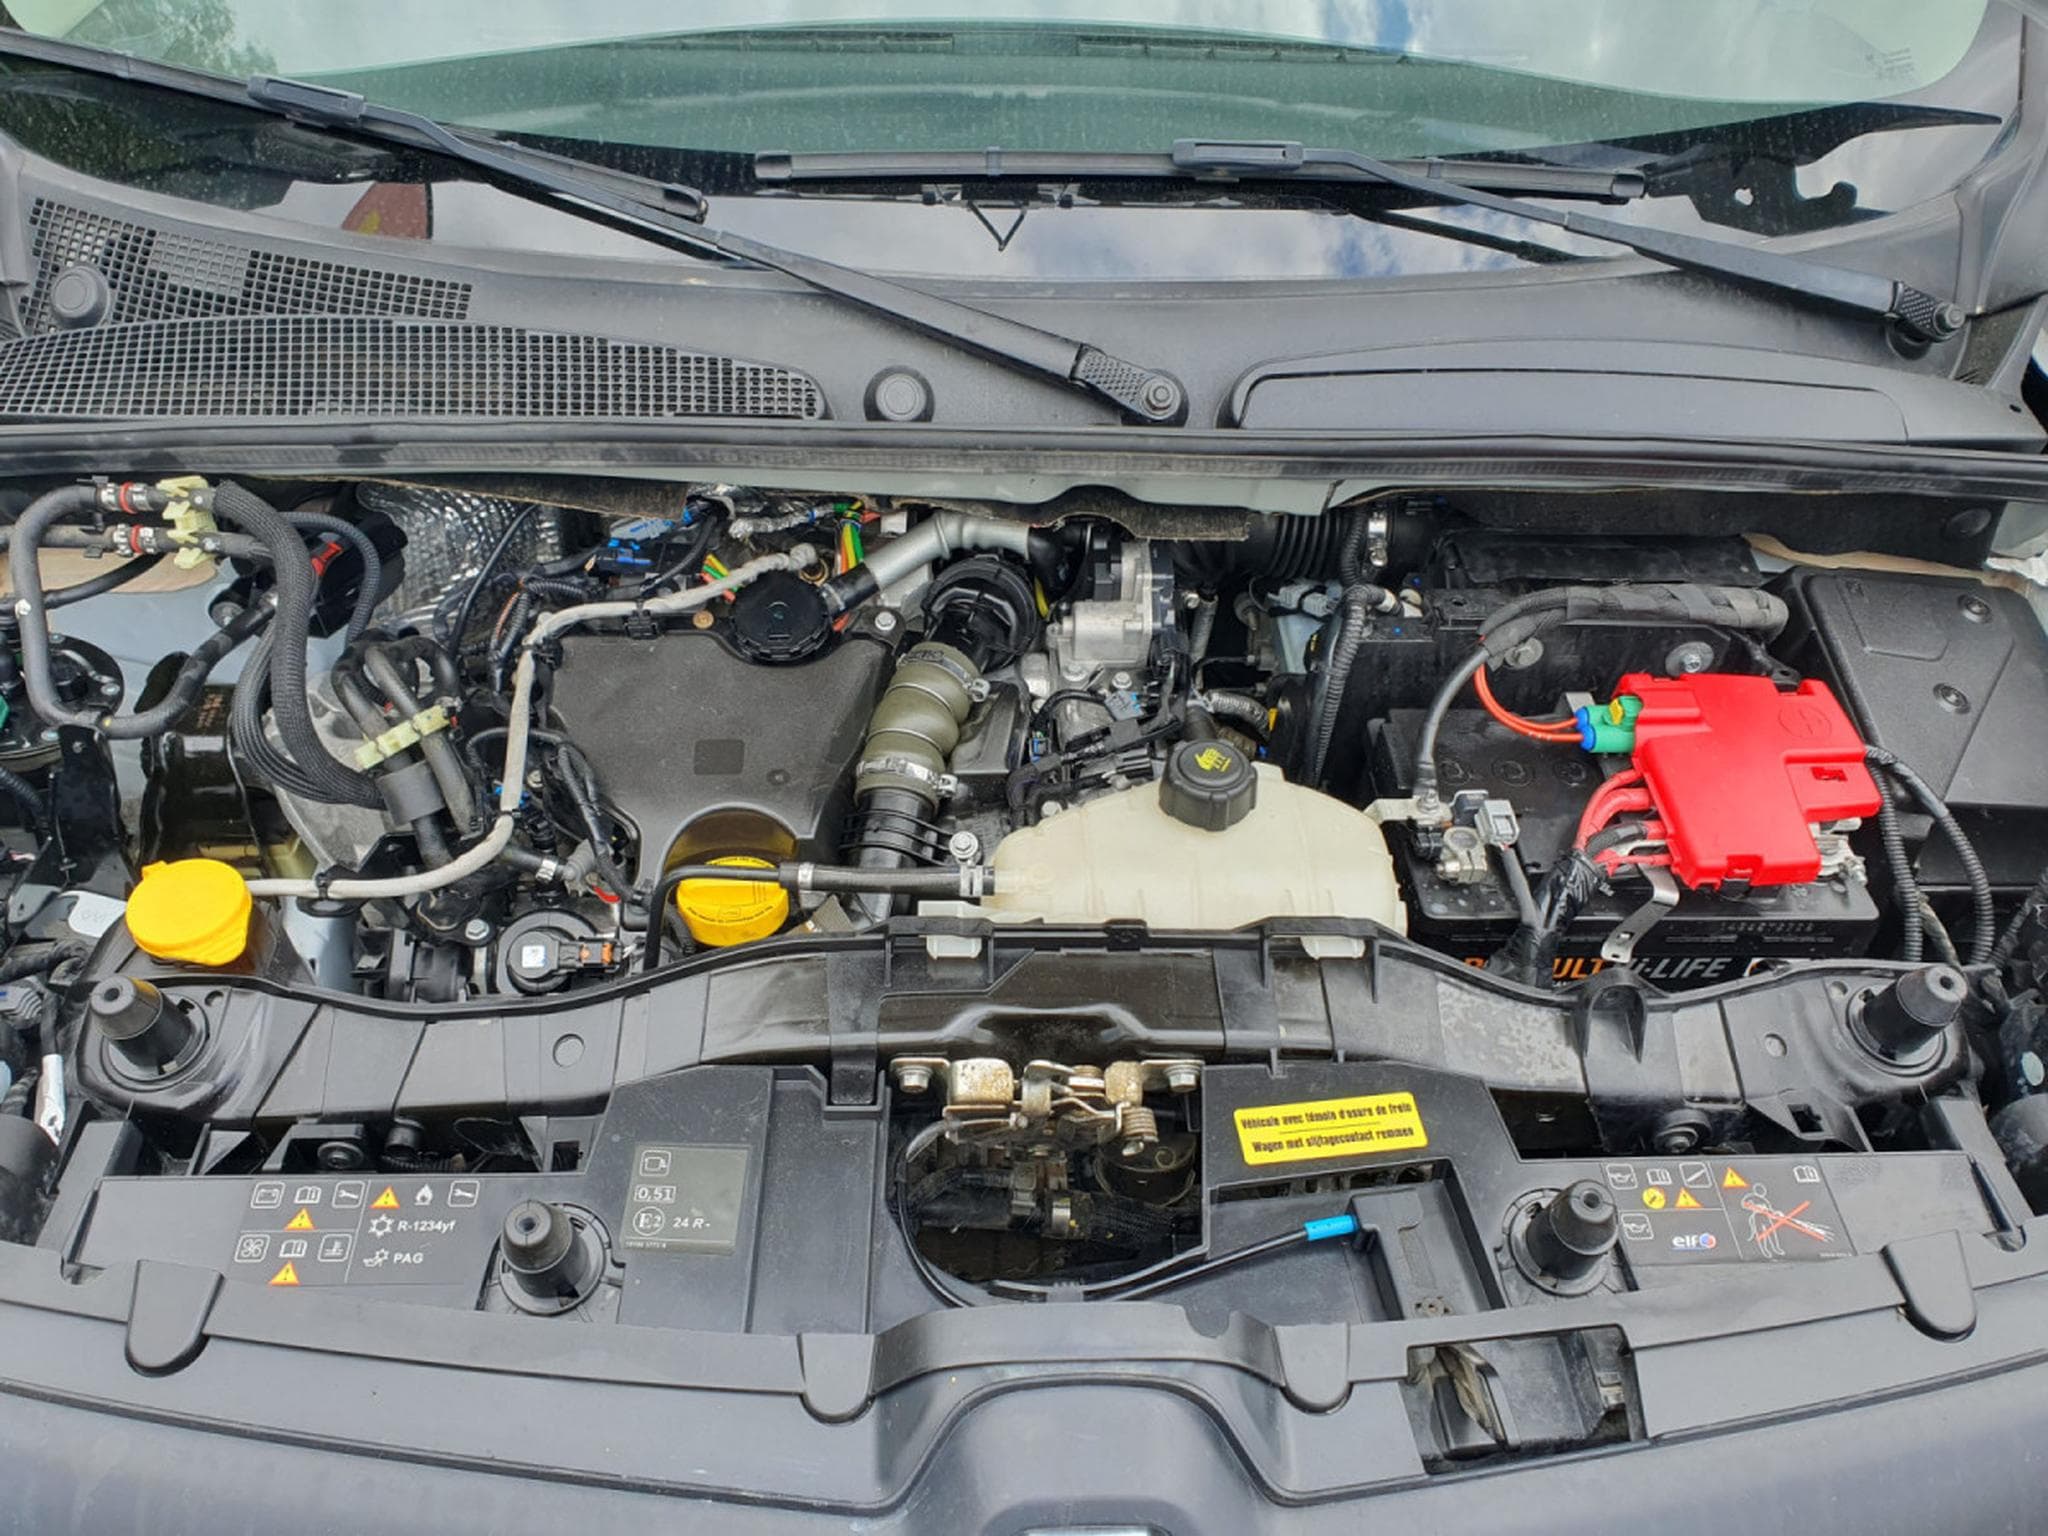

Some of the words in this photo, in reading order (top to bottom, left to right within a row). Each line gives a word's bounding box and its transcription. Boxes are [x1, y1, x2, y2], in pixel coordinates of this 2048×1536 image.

[1282, 1114, 1304, 1125] avec
[1376, 1105, 1387, 1115] de
[1388, 1102, 1412, 1114] frein
[1252, 1140, 1284, 1153] Wagen
[1286, 1137, 1304, 1149] met
[1376, 1126, 1414, 1139] remmen
[639, 1187, 671, 1201] 0,51
[397, 1219, 457, 1234] R-1234yf
[672, 1217, 689, 1229] 24
[1672, 1233, 1701, 1249] elf
[393, 1252, 424, 1264] PAG
